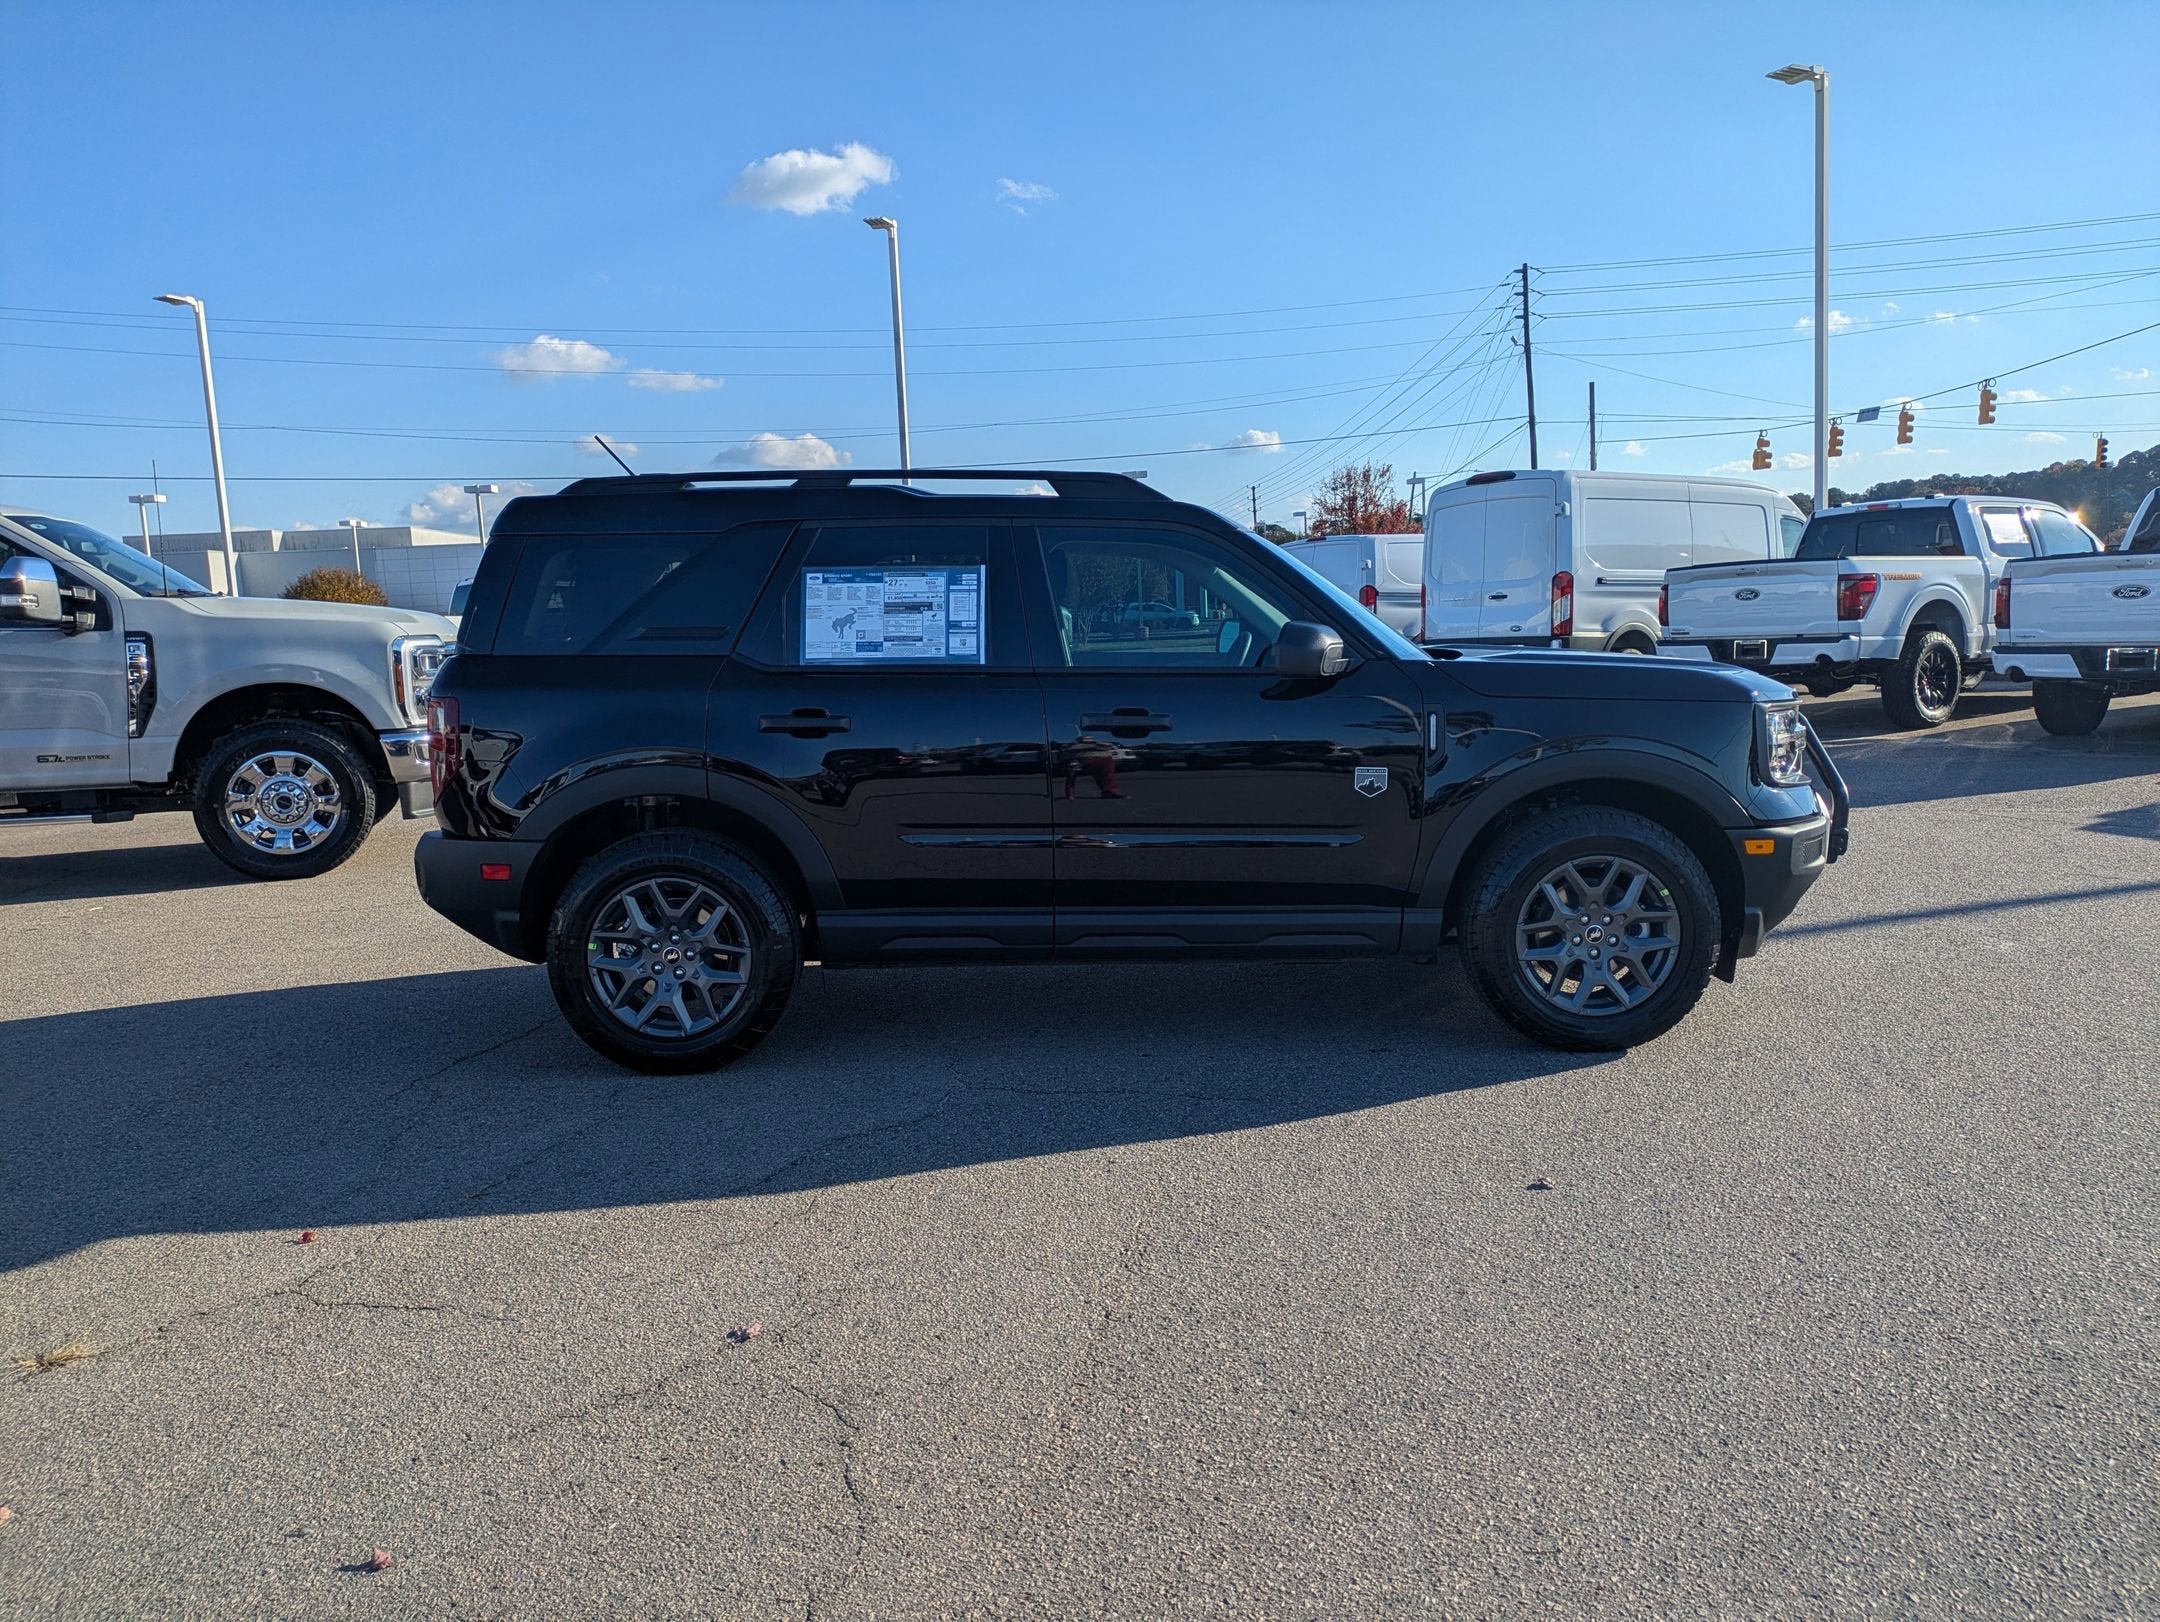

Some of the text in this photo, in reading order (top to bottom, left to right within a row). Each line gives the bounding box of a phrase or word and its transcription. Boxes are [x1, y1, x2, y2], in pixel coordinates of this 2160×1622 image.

[1882, 571, 1921, 581] TREMOR
[1737, 590, 1758, 600] Ford
[2115, 586, 2147, 599] Ford
